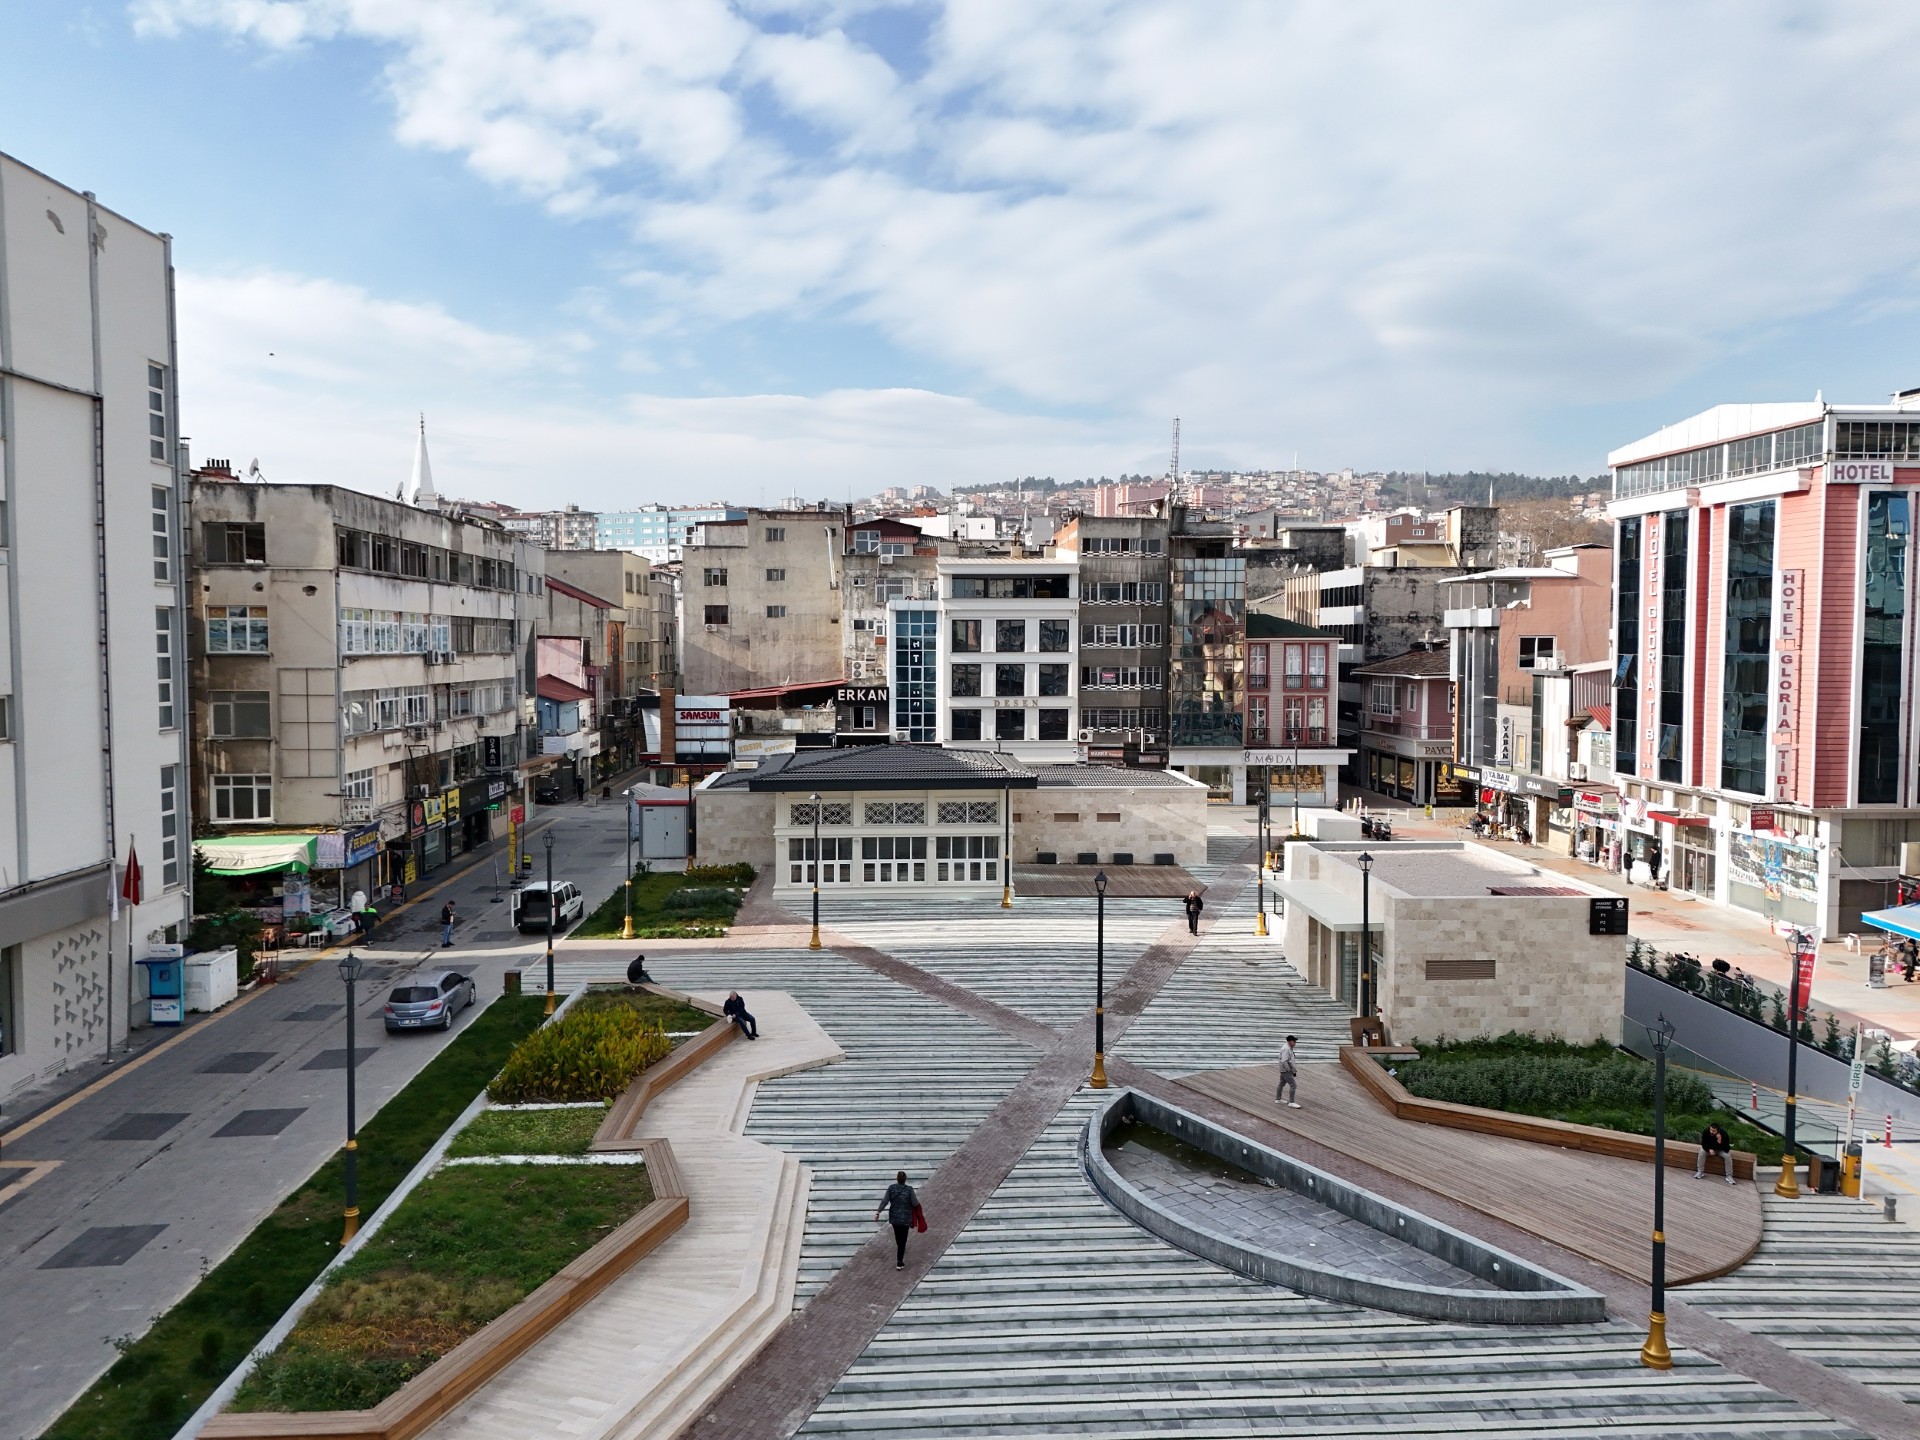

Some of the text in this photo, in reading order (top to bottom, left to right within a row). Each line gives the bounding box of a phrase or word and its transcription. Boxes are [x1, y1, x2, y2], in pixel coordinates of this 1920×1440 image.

[1834, 465, 1890, 480] HOTEL
[1650, 525, 1659, 597] HOTEL
[1782, 574, 1795, 636] HOTEL
[837, 689, 888, 701] ERKAN
[993, 699, 1039, 707] DESEN
[680, 711, 720, 720] SAMSUN
[1502, 725, 1510, 760] YABAN
[1488, 770, 1511, 782] YABAN
[1851, 1063, 1863, 1089] GİRİŞ
